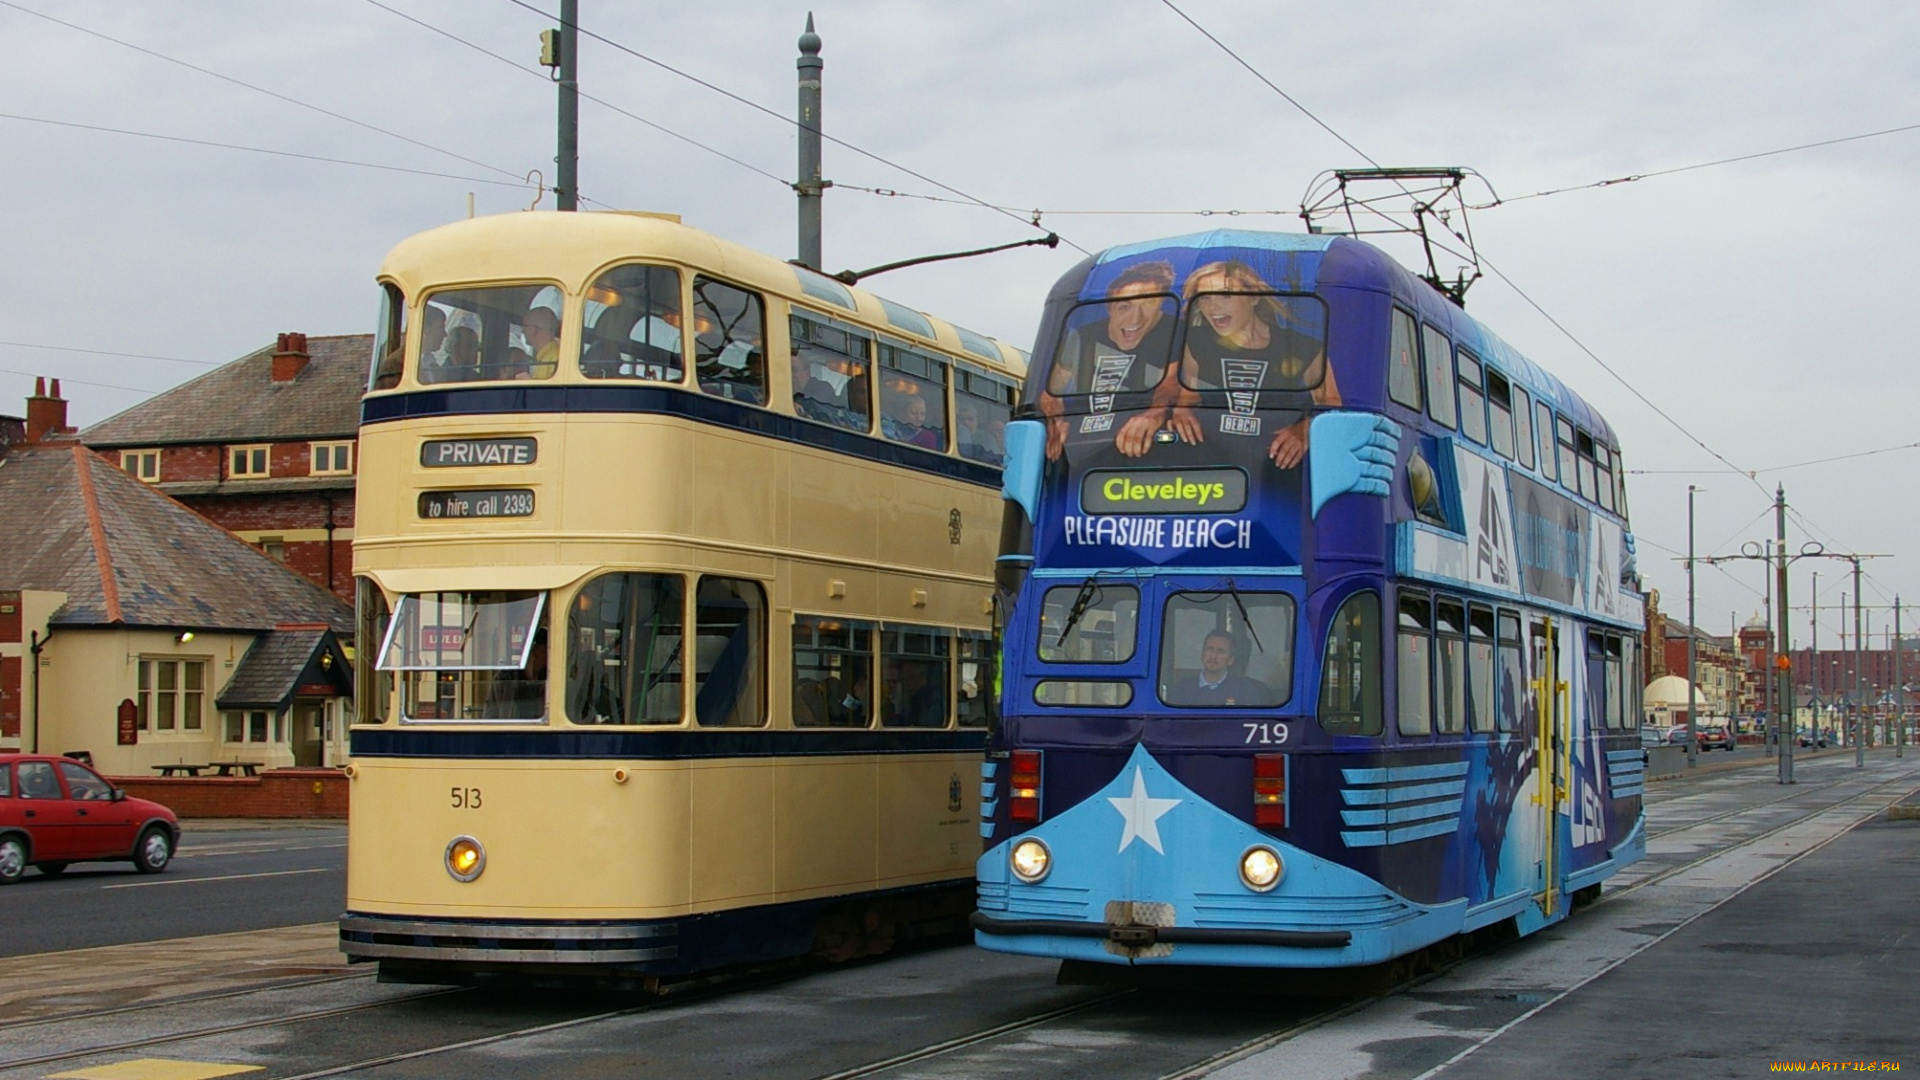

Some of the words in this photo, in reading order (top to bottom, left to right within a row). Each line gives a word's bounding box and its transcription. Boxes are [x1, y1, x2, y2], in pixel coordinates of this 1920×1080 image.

[1094, 358, 1130, 411] PLEASRE
[1227, 362, 1262, 412] PLEAURE
[1225, 417, 1257, 433] BEACH
[439, 443, 528, 464] PRIVATE
[1103, 477, 1224, 505] Cleveleys
[429, 501, 441, 517] to
[446, 498, 469, 516] hire
[476, 496, 498, 515] call
[504, 494, 533, 514] 2393
[1064, 516, 1166, 548] PLEASURE
[1172, 519, 1251, 549] BEACH
[1243, 723, 1289, 744] 719
[451, 787, 482, 809] 513
